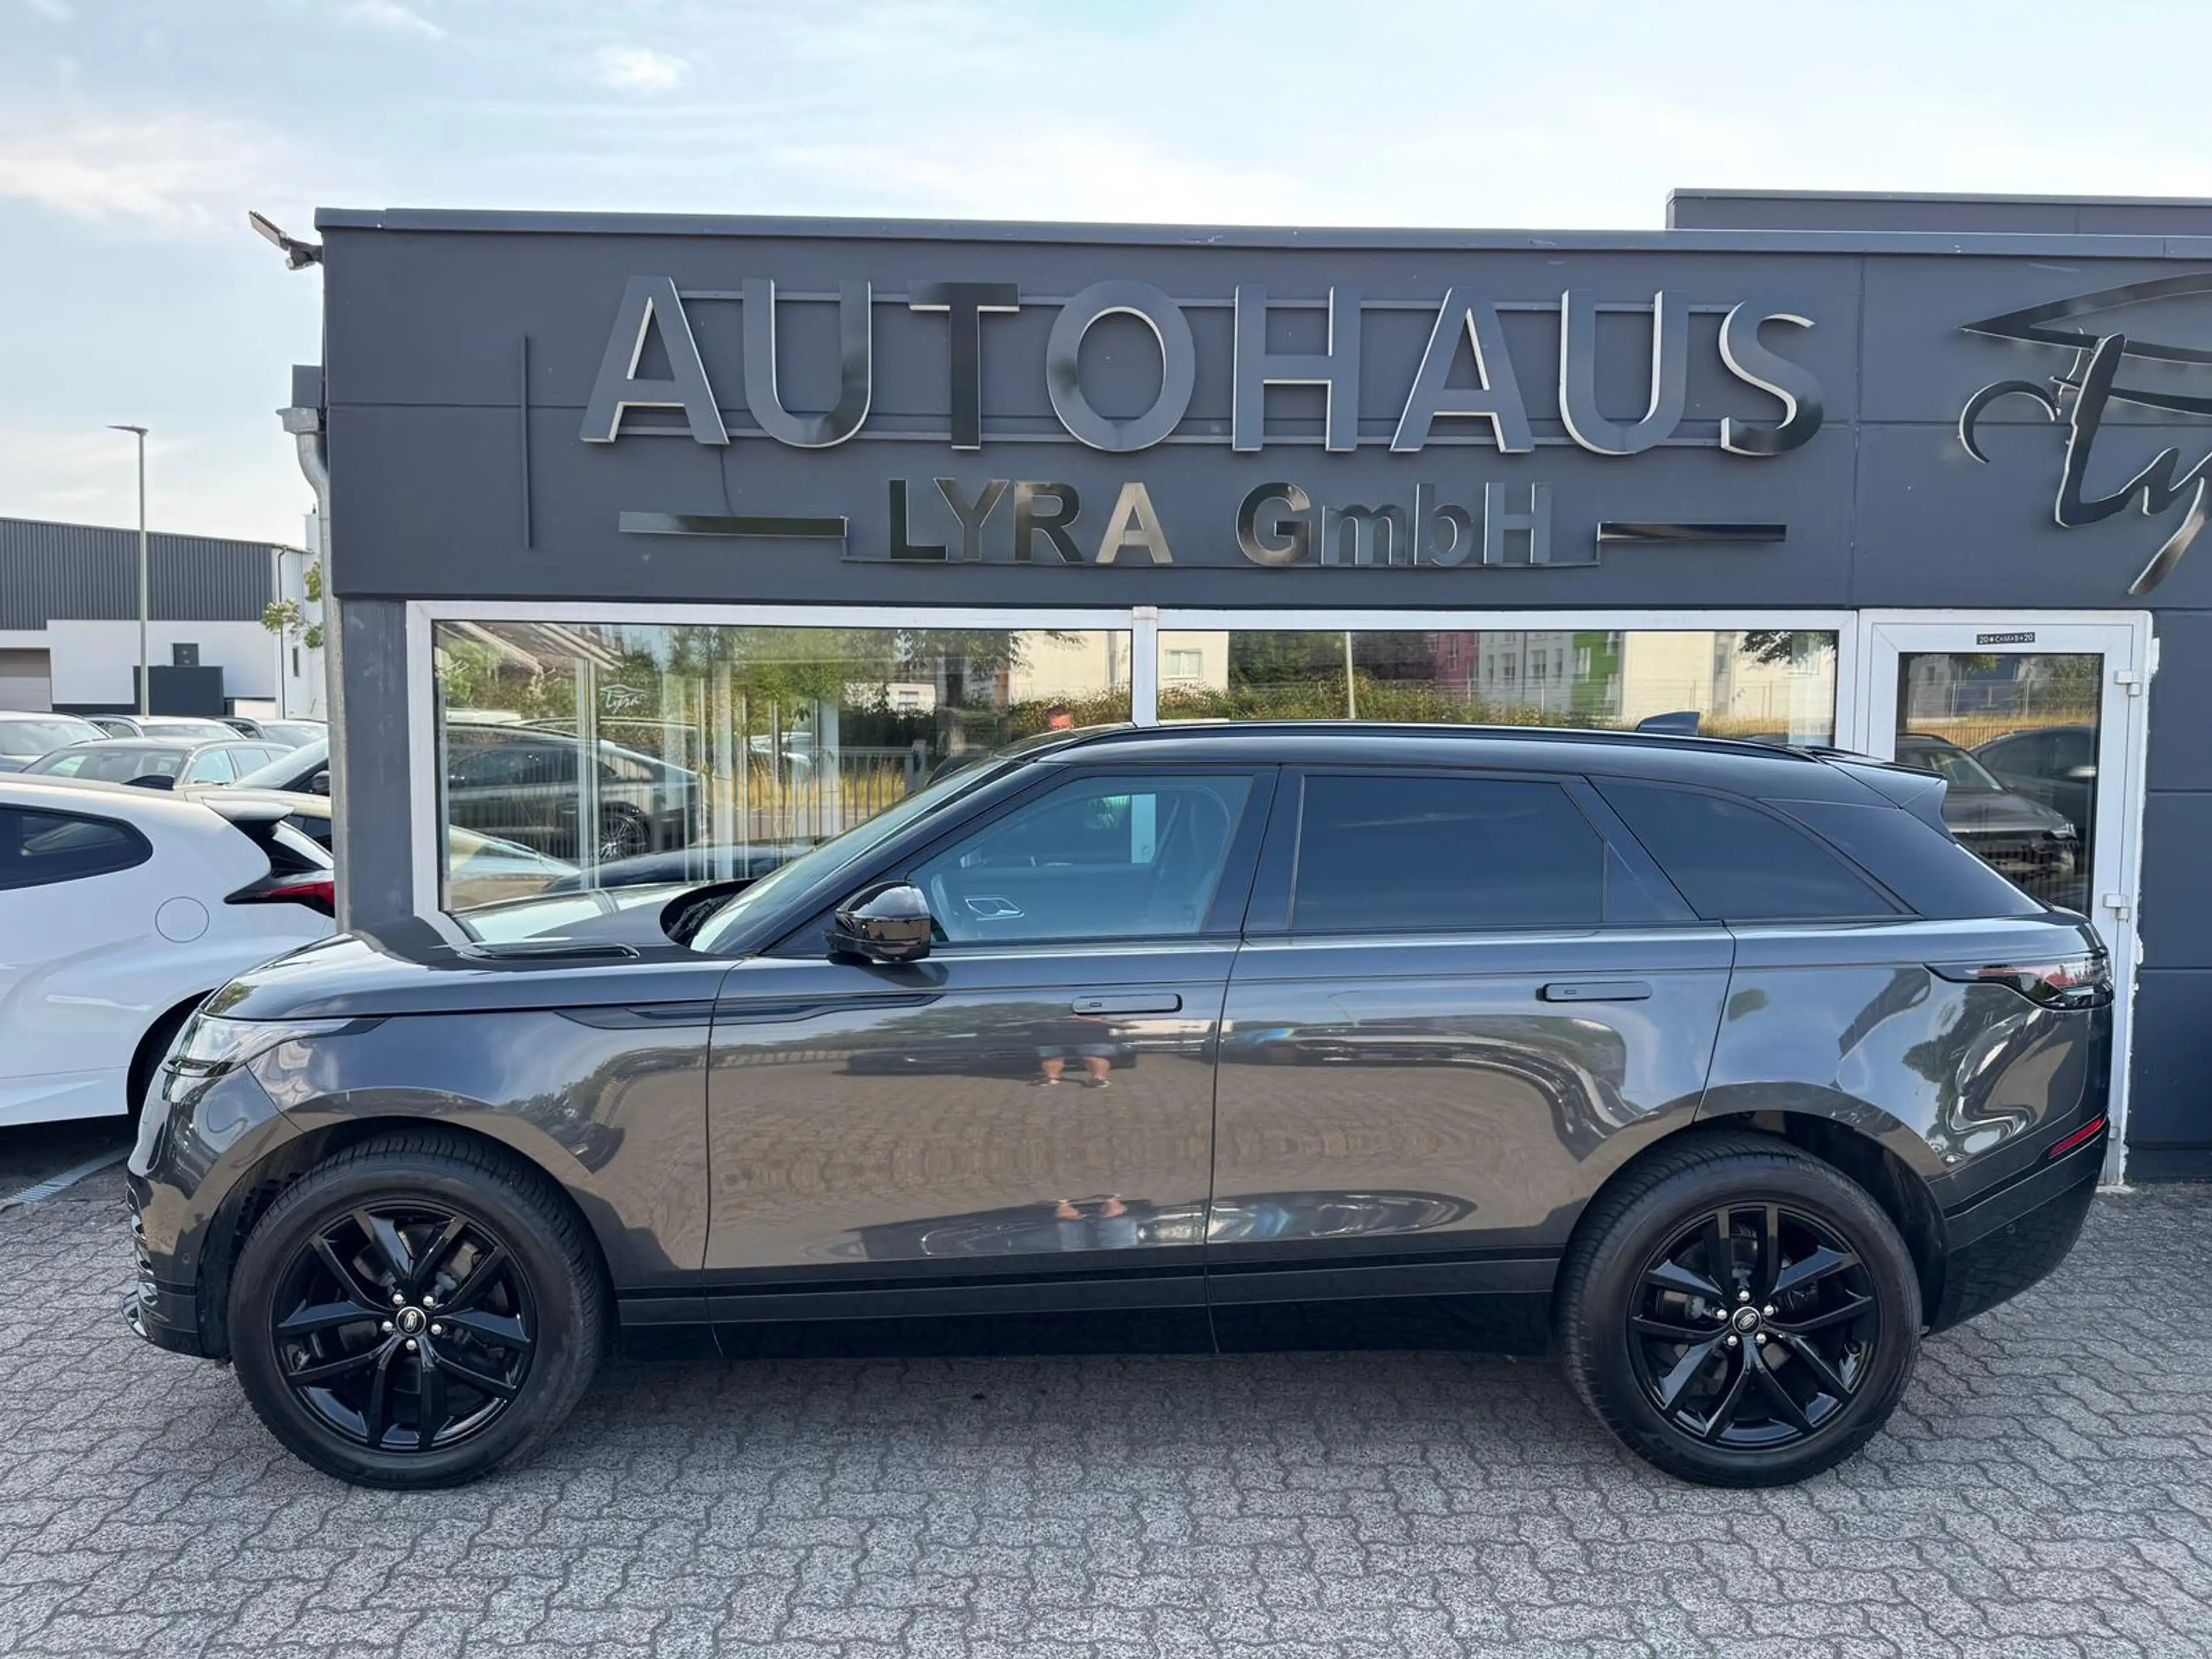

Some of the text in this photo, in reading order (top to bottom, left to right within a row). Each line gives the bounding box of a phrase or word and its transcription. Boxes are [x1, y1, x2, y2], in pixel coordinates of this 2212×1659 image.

[578, 275, 1824, 456] AUTOHAUS
[888, 476, 1554, 567] LYRA GmbH
